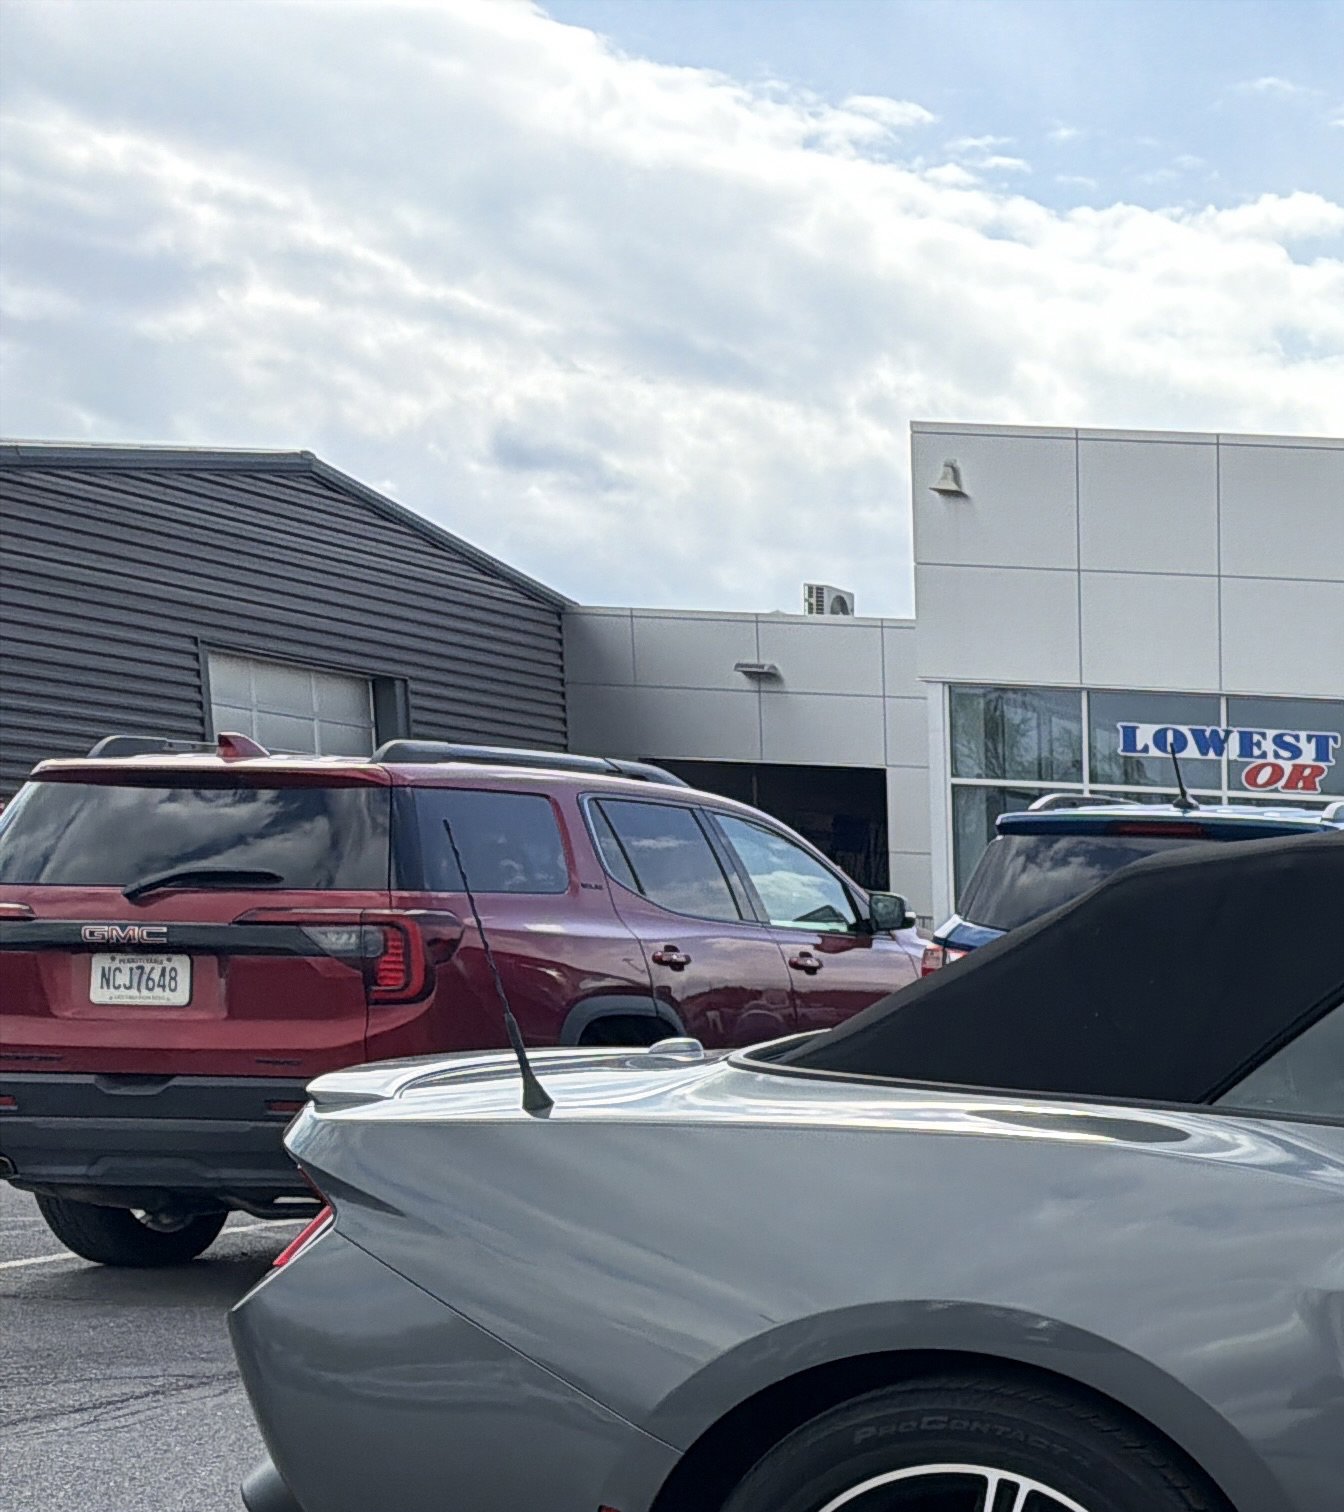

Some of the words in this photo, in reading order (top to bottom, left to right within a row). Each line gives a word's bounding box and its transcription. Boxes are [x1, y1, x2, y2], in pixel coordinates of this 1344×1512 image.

[1120, 725, 1340, 765] LOWEST
[1244, 762, 1326, 793] OR
[81, 925, 168, 944] GMC
[100, 964, 178, 993] NCJ7648
